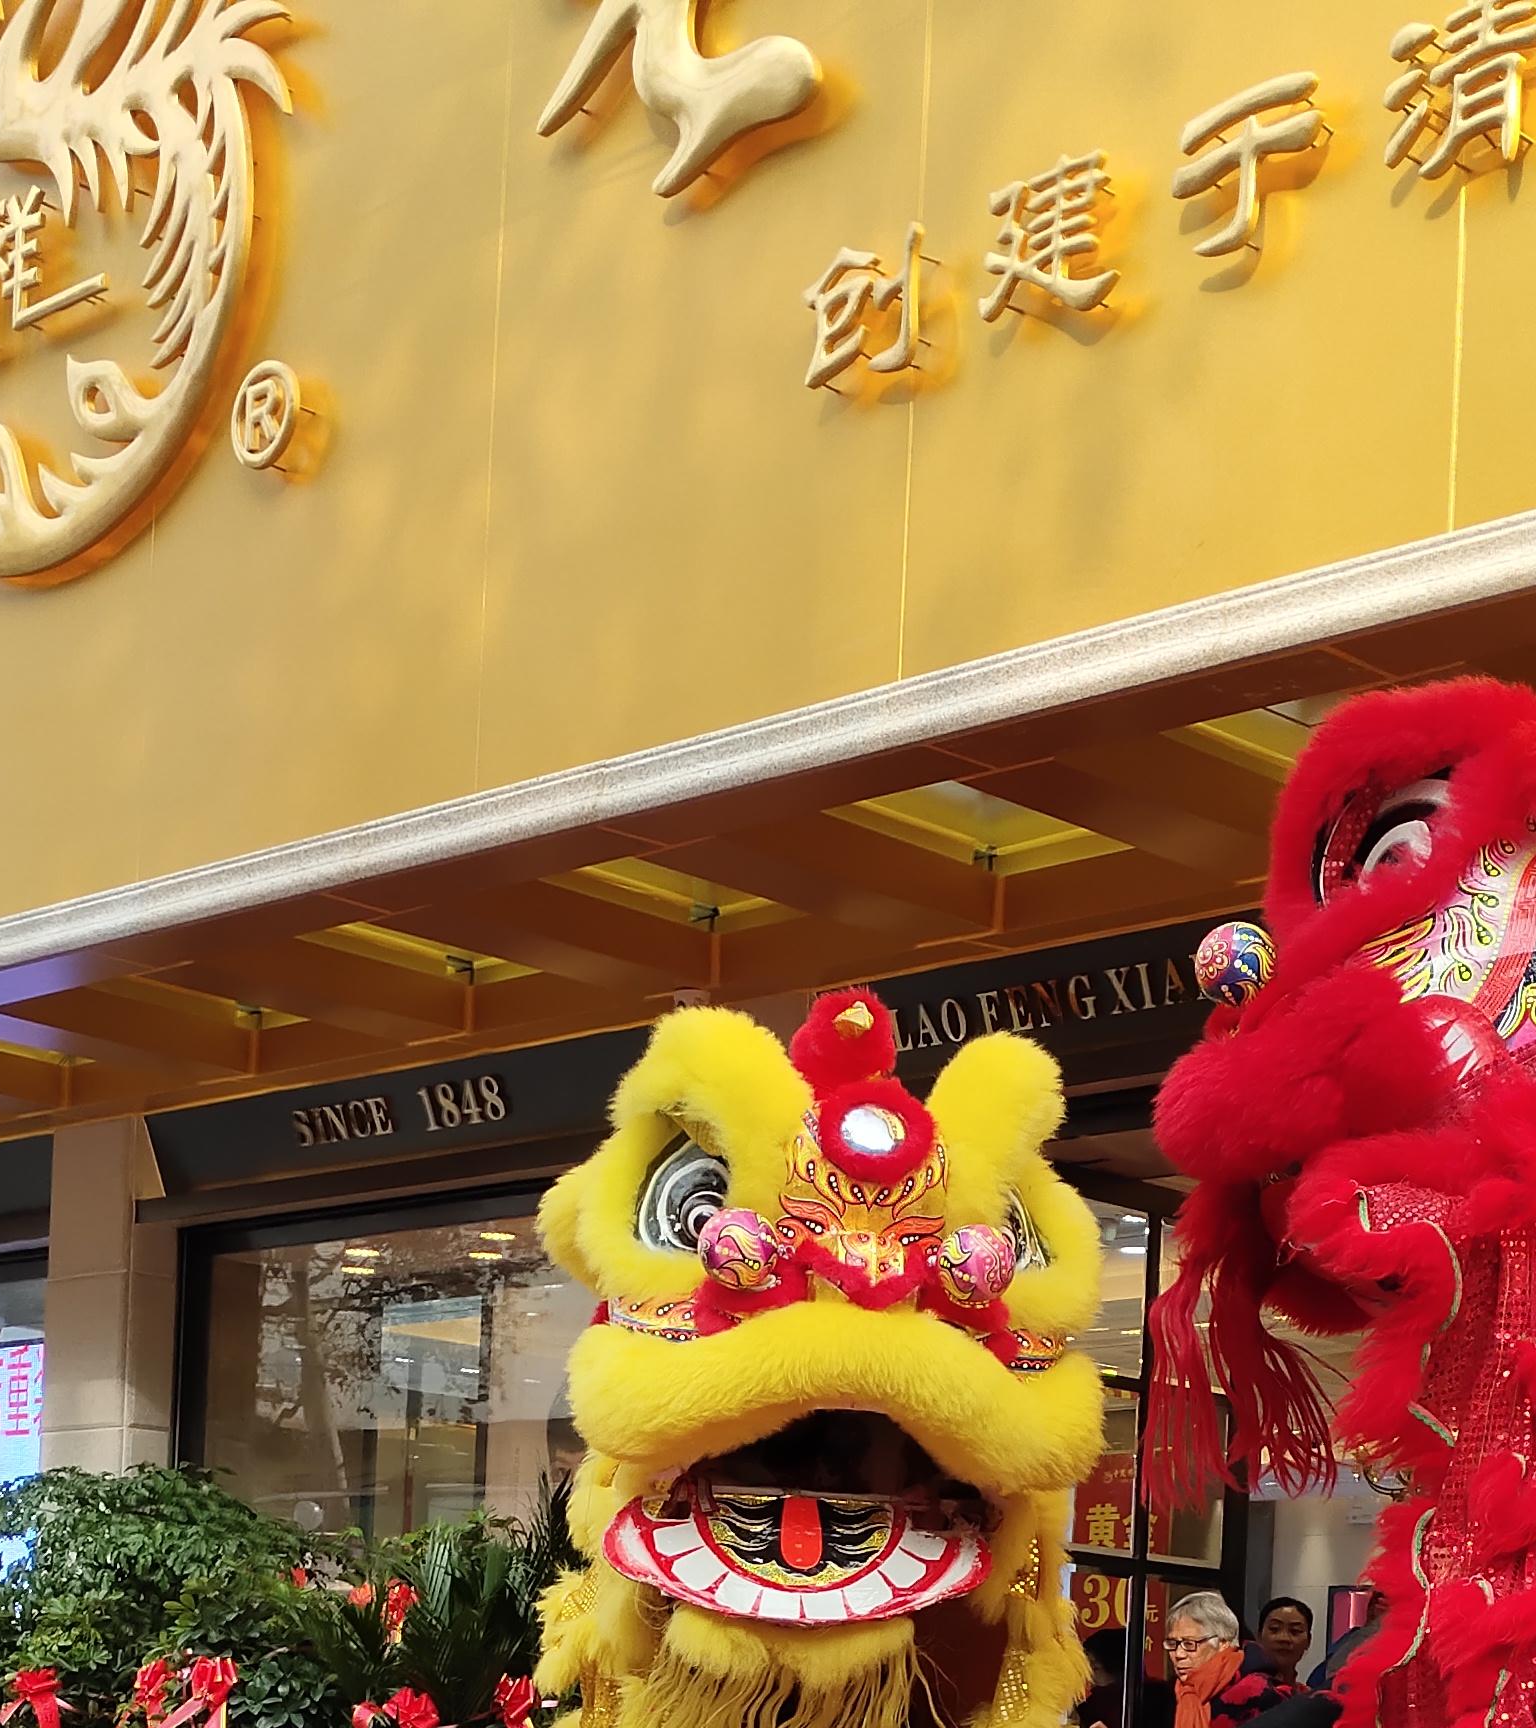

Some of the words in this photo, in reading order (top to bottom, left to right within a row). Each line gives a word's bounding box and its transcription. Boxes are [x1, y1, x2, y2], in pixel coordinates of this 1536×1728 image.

[890, 997, 967, 1053] LAO
[976, 974, 1098, 1036] FENG
[292, 1096, 395, 1147] SINCE
[416, 1074, 507, 1132] 1848
